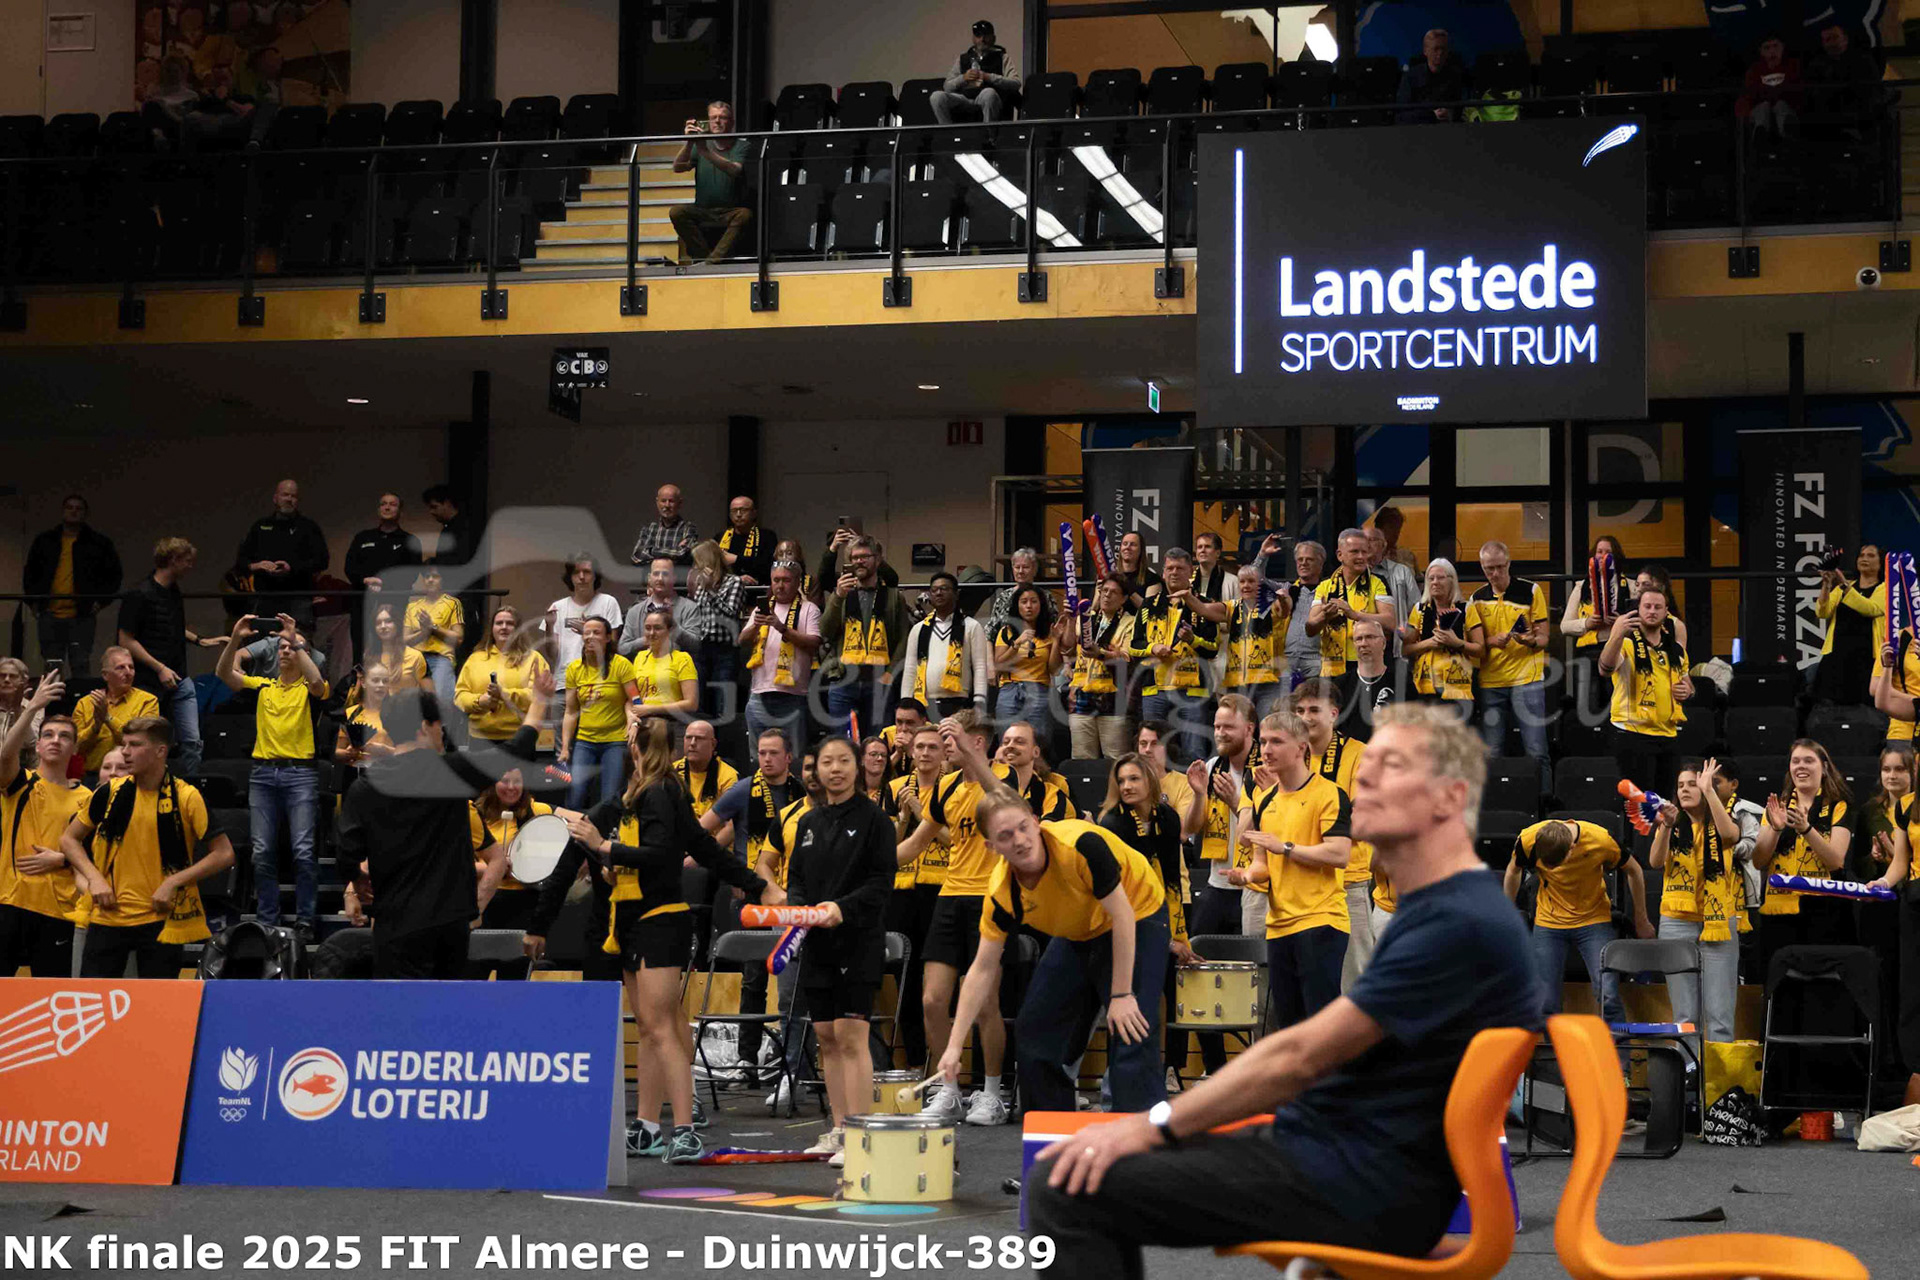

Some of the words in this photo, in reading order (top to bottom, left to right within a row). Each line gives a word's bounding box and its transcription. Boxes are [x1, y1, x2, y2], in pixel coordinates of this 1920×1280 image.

[1280, 244, 1596, 317] Landstede
[1280, 324, 1597, 373] SPORTCENTRUM
[1131, 489, 1160, 532] FZ
[1775, 473, 1786, 548] INNOVATED
[1795, 473, 1825, 519] FZ
[1064, 548, 1077, 597] VICTOR
[1776, 555, 1786, 570] IN
[1776, 577, 1787, 640] DENMARK
[1803, 877, 1870, 893] VICTOR
[355, 1051, 591, 1083] NEDERLANDSE
[218, 1097, 252, 1106] TeamNL
[351, 1088, 489, 1121] LOTERIJ
[0, 1120, 109, 1147] INTON
[0, 1150, 82, 1172] RLAND
